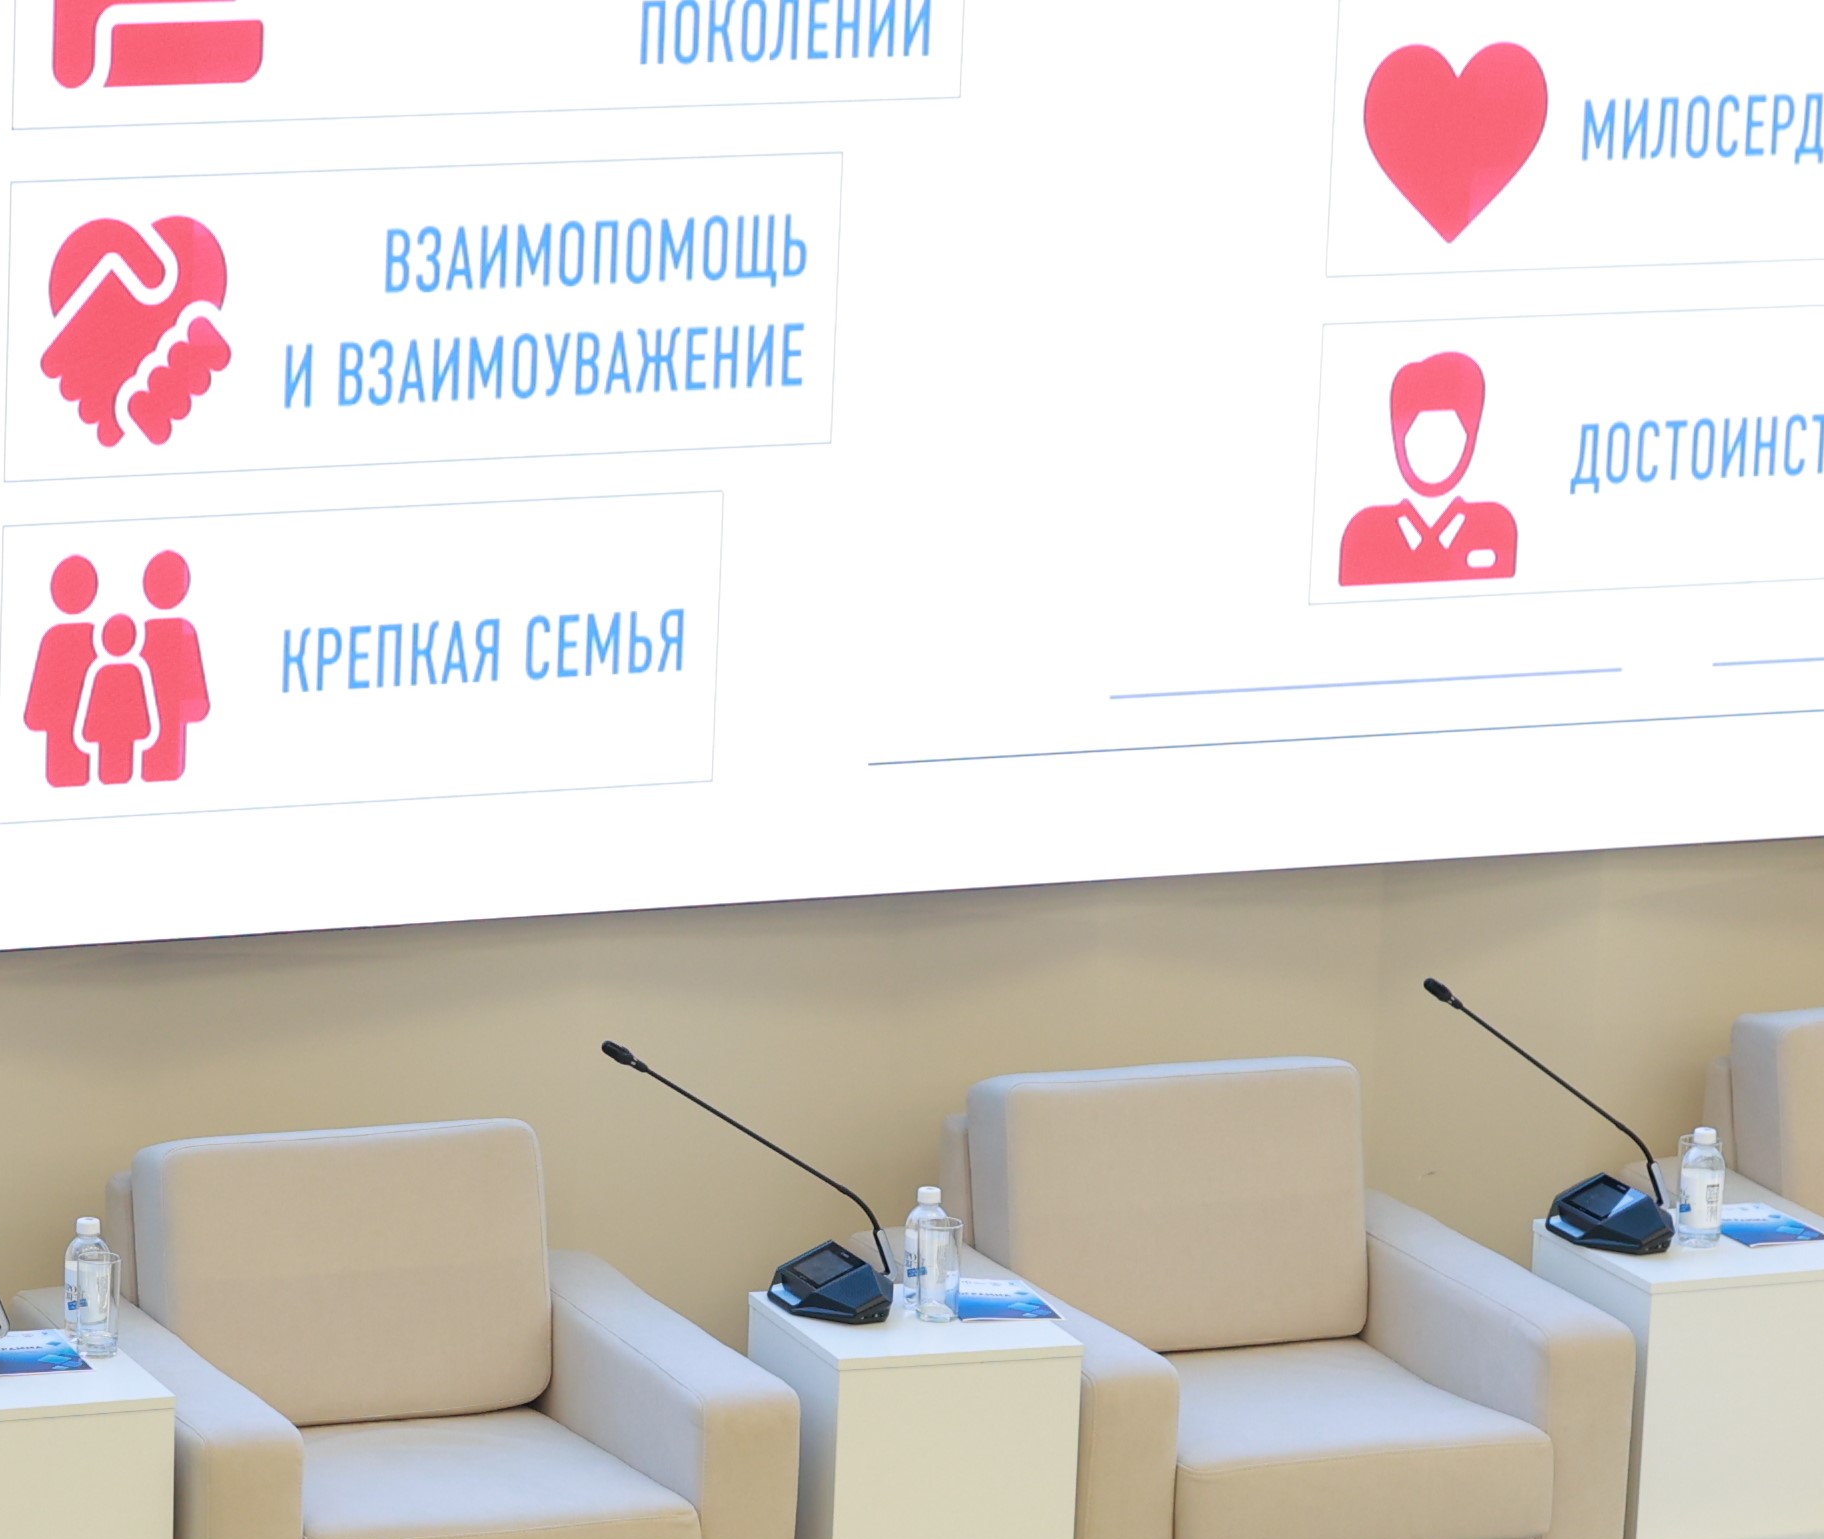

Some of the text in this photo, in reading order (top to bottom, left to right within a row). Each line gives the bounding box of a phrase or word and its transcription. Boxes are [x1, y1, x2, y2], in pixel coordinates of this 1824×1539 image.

[383, 212, 809, 296] ВЗАИМОПОМОЩЬ
[282, 320, 807, 411] И ВЗАИМОУВАЖЕНИЕ
[280, 606, 686, 695] КРЕПКАЯ СЕМЬЯ
